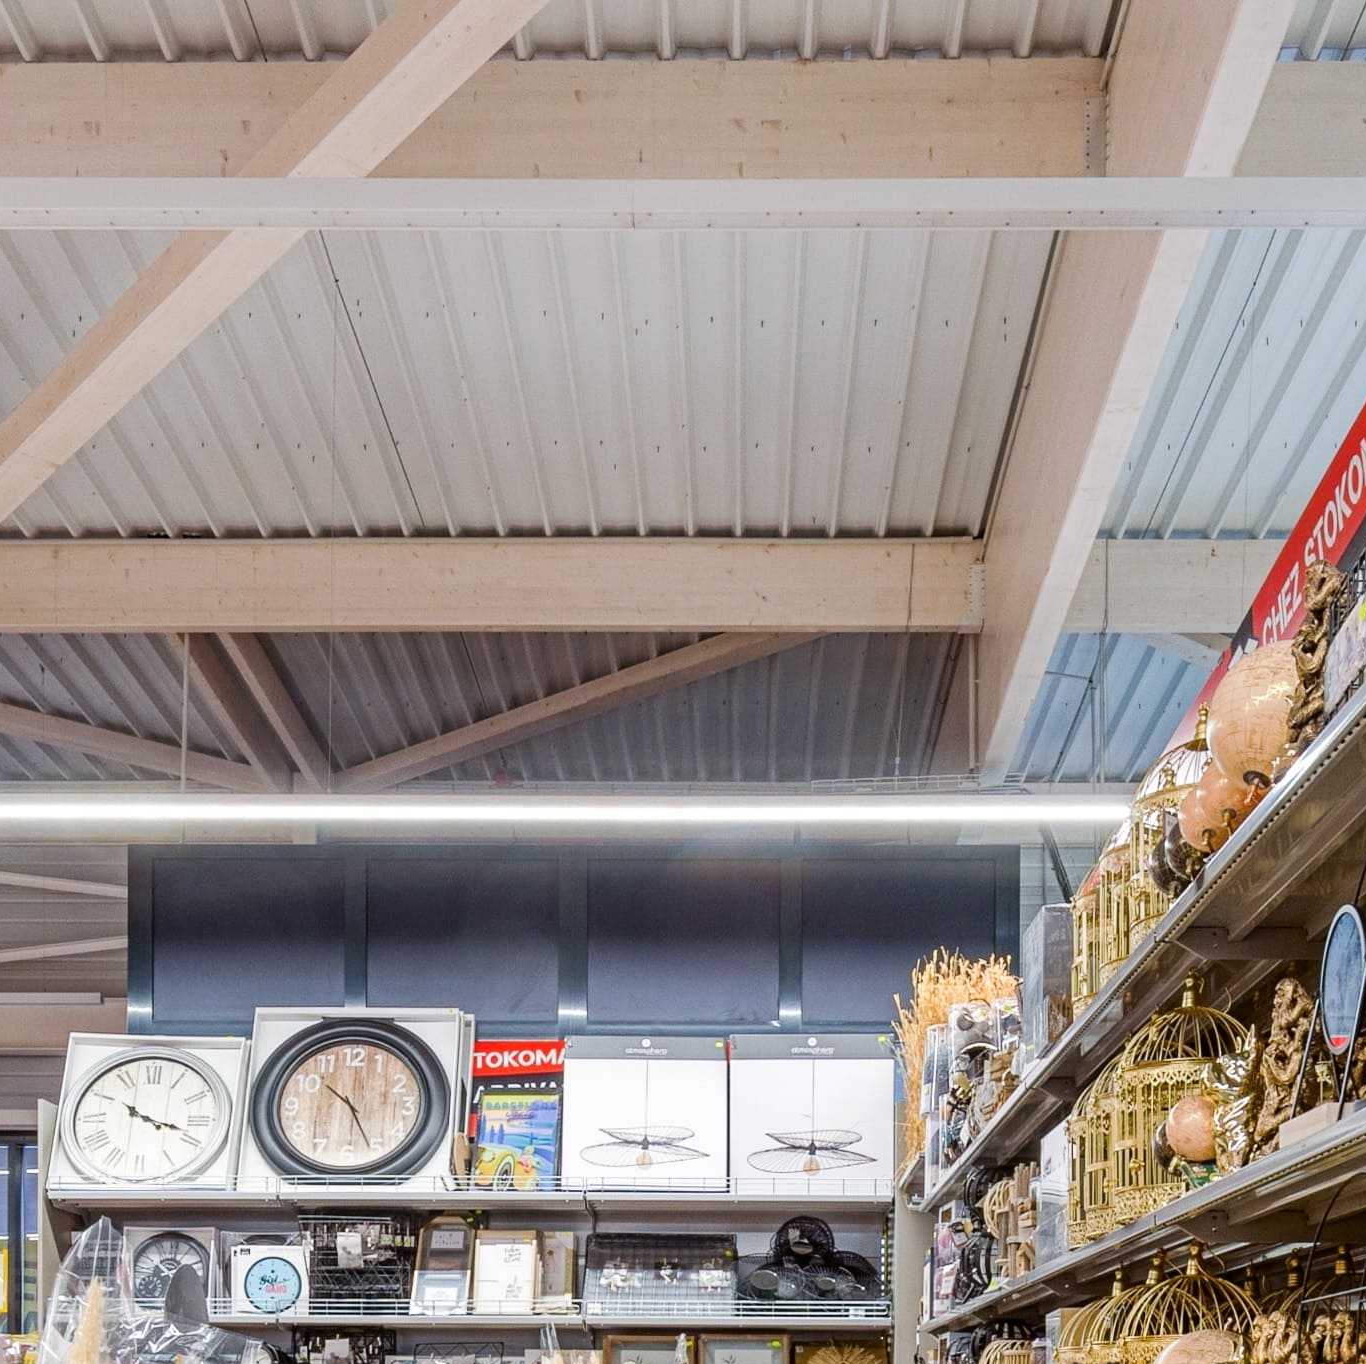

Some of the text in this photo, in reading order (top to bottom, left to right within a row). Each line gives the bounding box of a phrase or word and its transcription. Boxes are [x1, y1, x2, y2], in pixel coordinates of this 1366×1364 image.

[1262, 563, 1303, 644] CHEZ
[318, 1054, 335, 1073] 11
[344, 1048, 365, 1067] 12
[375, 1054, 383, 1072] 1
[296, 1074, 320, 1093] 10
[393, 1075, 407, 1092] 2
[285, 1097, 299, 1115] 9
[402, 1097, 415, 1115] 3
[291, 1122, 306, 1140] 8
[390, 1122, 404, 1137] 4
[313, 1138, 327, 1155] 7
